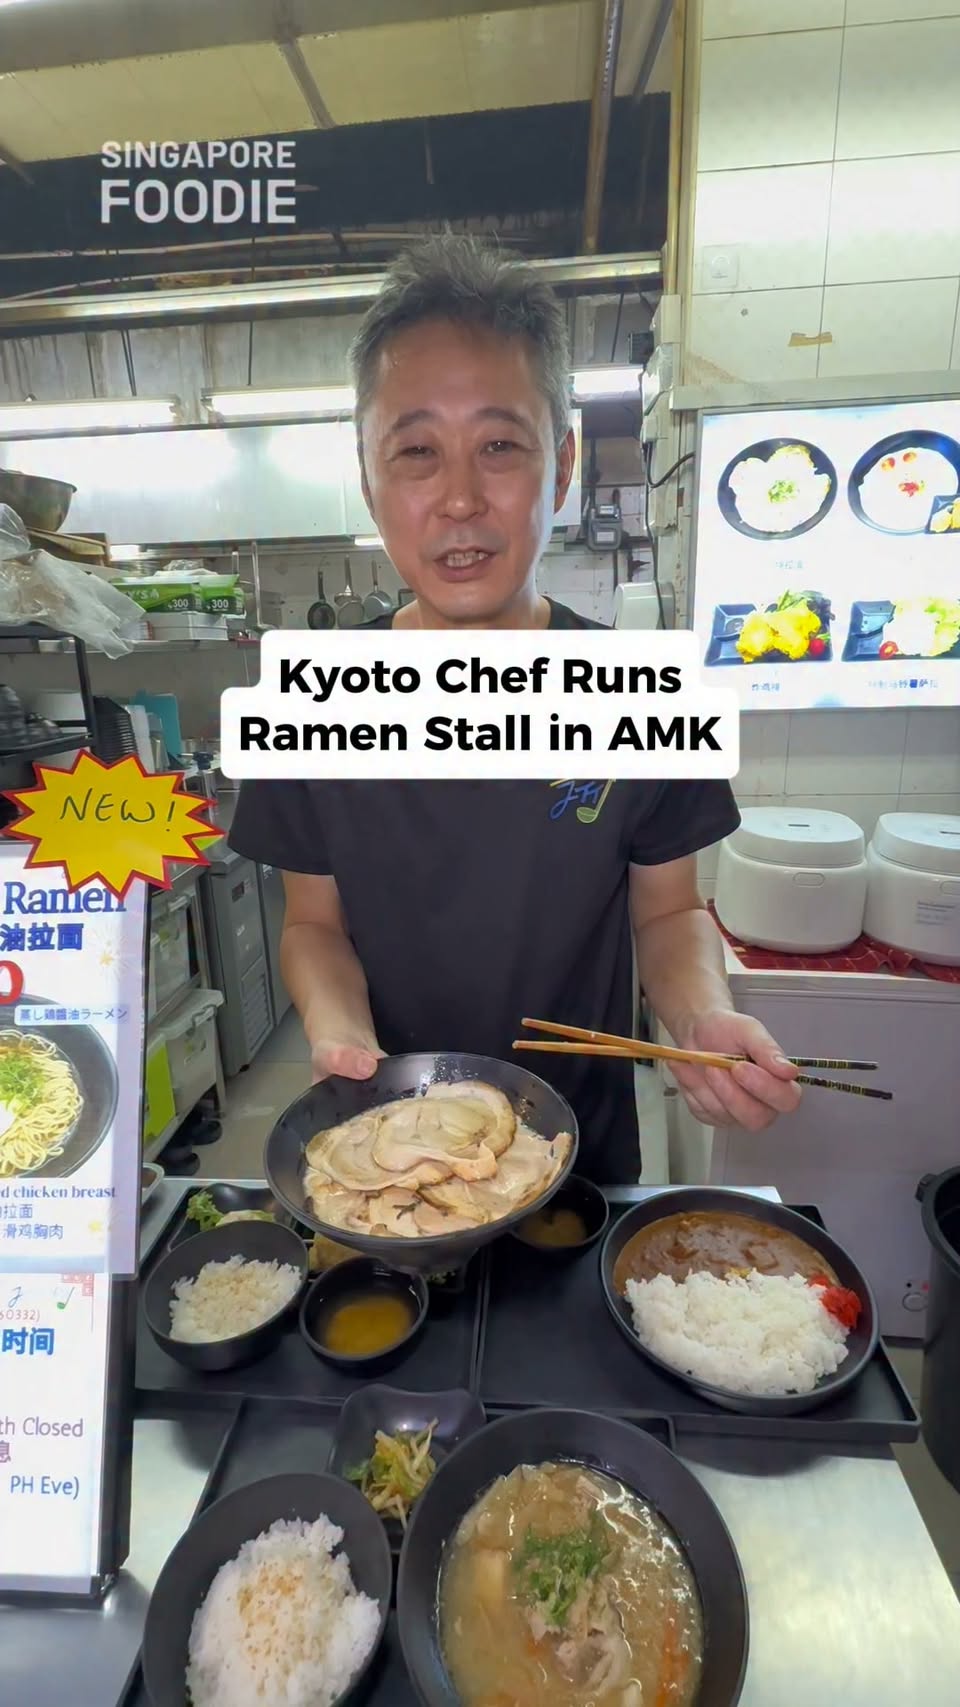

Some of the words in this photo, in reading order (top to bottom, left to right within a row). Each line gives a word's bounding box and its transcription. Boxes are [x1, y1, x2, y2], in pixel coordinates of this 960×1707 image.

[211, 599, 229, 609] 300
[59, 787, 176, 832] NEW!
[0, 1185, 10, 1198] d
[13, 1185, 68, 1198] chicken
[71, 1185, 117, 1198] breast
[0, 1203, 33, 1219] 拉面
[2, 1327, 55, 1355] 时间
[22, 1415, 84, 1438] Closed
[10, 1475, 34, 1494] PH
[40, 1475, 80, 1500] Eve)
